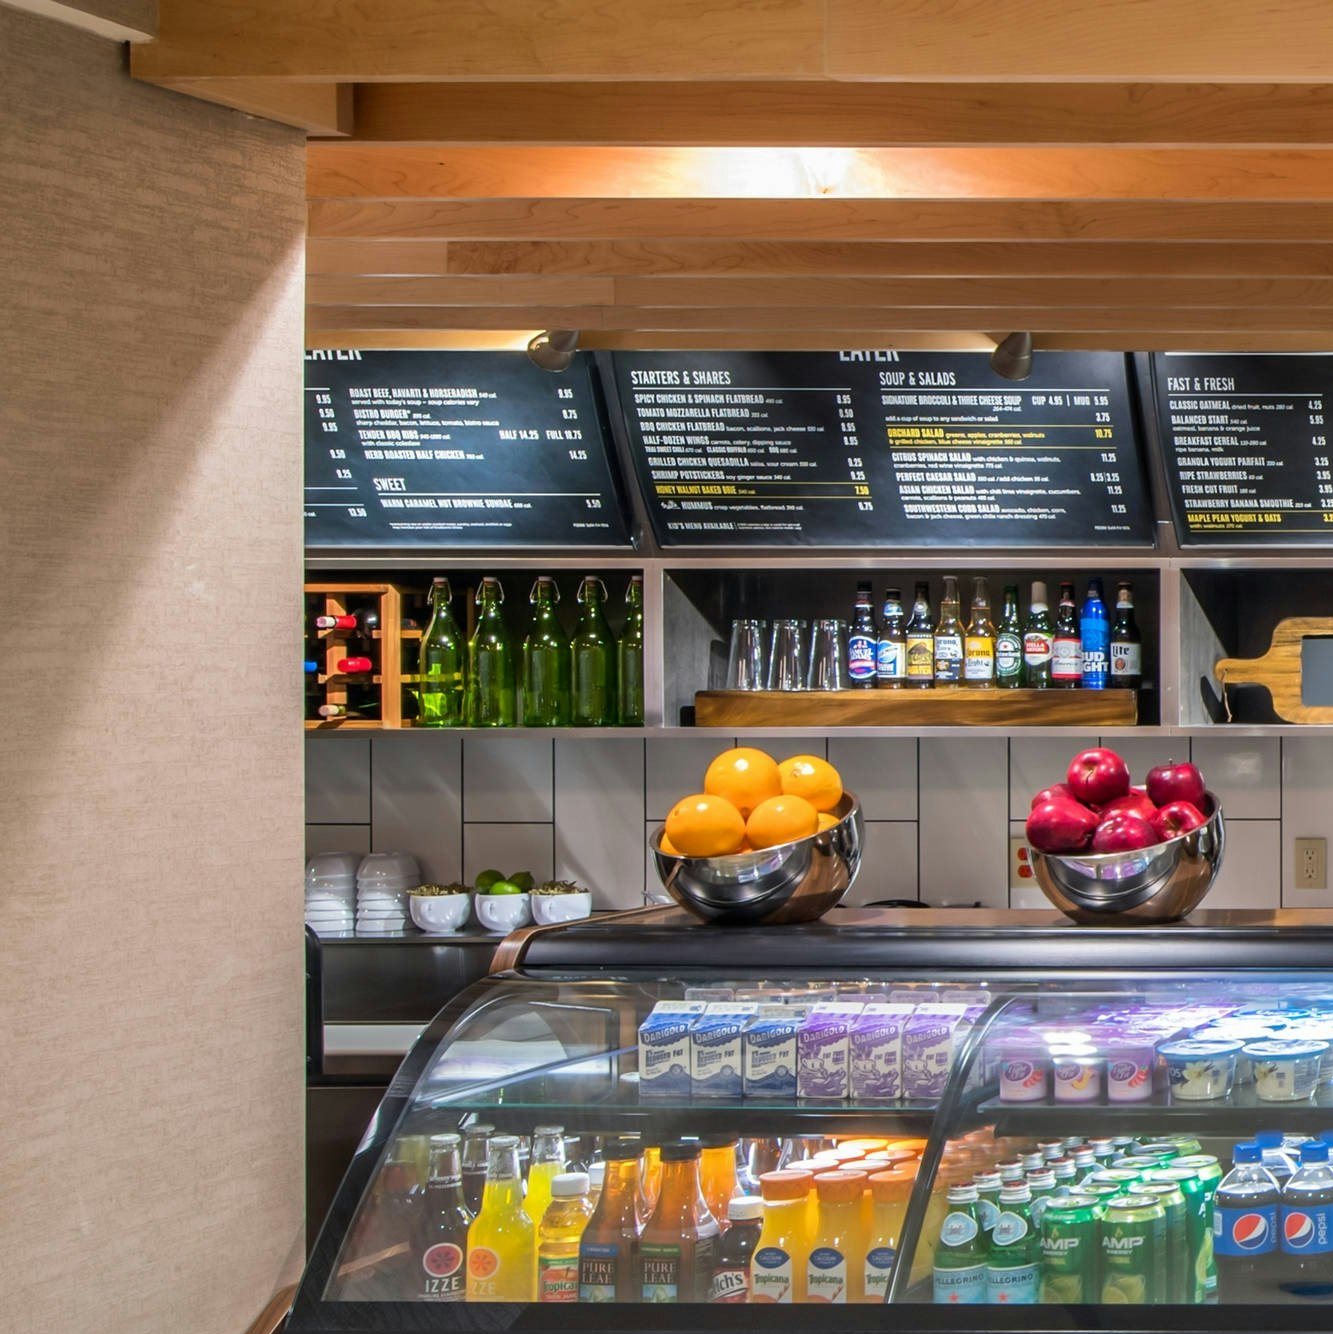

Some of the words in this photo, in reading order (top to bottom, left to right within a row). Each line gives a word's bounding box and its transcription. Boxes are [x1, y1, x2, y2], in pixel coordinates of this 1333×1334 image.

[631, 371, 679, 385] STARTERS
[683, 371, 690, 385] &
[693, 371, 731, 385] SHARES
[880, 372, 905, 385] SOUP
[909, 372, 916, 385] &
[919, 372, 956, 385] SALADS
[1168, 377, 1190, 391] FAST
[1194, 377, 1200, 391] &
[1204, 377, 1235, 391] FRESH
[373, 478, 406, 491] SWEET
[1082, 652, 1104, 661] UD
[644, 1025, 685, 1042] DARIGOLD
[696, 1026, 737, 1043] DARIGOLD
[750, 1027, 791, 1043] DARIGOLD
[804, 1026, 845, 1042] DARIGOLD
[855, 1027, 895, 1044] DARIGOLD
[906, 1027, 947, 1044] DARIGOLD
[1317, 1213, 1328, 1245] pepsi
[1040, 1237, 1079, 1249] AMP
[1102, 1236, 1144, 1248] AMP
[583, 1262, 613, 1273] PURE
[644, 1262, 676, 1273] PURE
[644, 1273, 674, 1283] LEAF
[754, 1274, 789, 1284] Tropicana
[808, 1274, 843, 1285] Tropicana
[425, 1278, 460, 1293] IZZE
